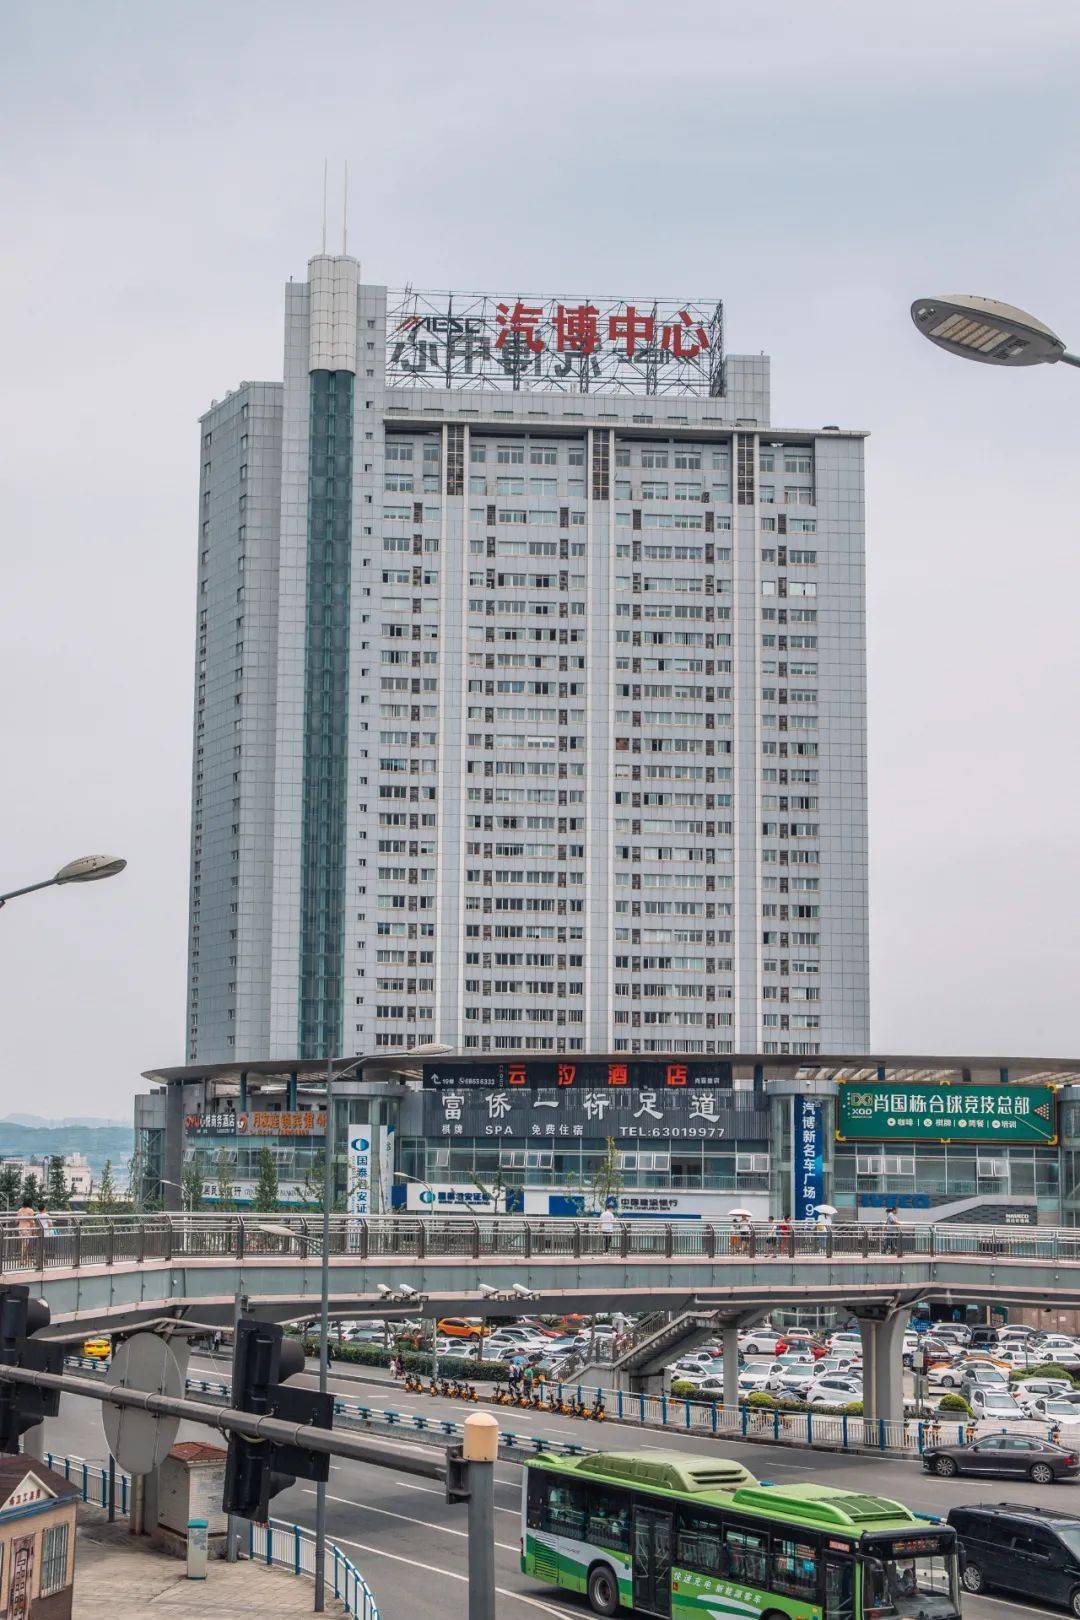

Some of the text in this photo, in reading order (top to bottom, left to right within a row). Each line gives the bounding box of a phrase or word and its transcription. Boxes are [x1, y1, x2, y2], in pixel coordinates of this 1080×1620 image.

[495, 302, 710, 358] 汽博中心
[441, 1092, 721, 1123] 富侨一衍足道
[874, 1094, 1030, 1115] 肖国栋台球竞技总部
[441, 1124, 725, 1137] 棋牌 SPA 免费住宿 TEL:63019977
[897, 1118, 914, 1127] 咖啡
[935, 1119, 952, 1127] 棋牌
[802, 1102, 816, 1199] 汽博新名车广场
[621, 1198, 679, 1207] 中国建设银行
[673, 1571, 712, 1590] 快速充电
